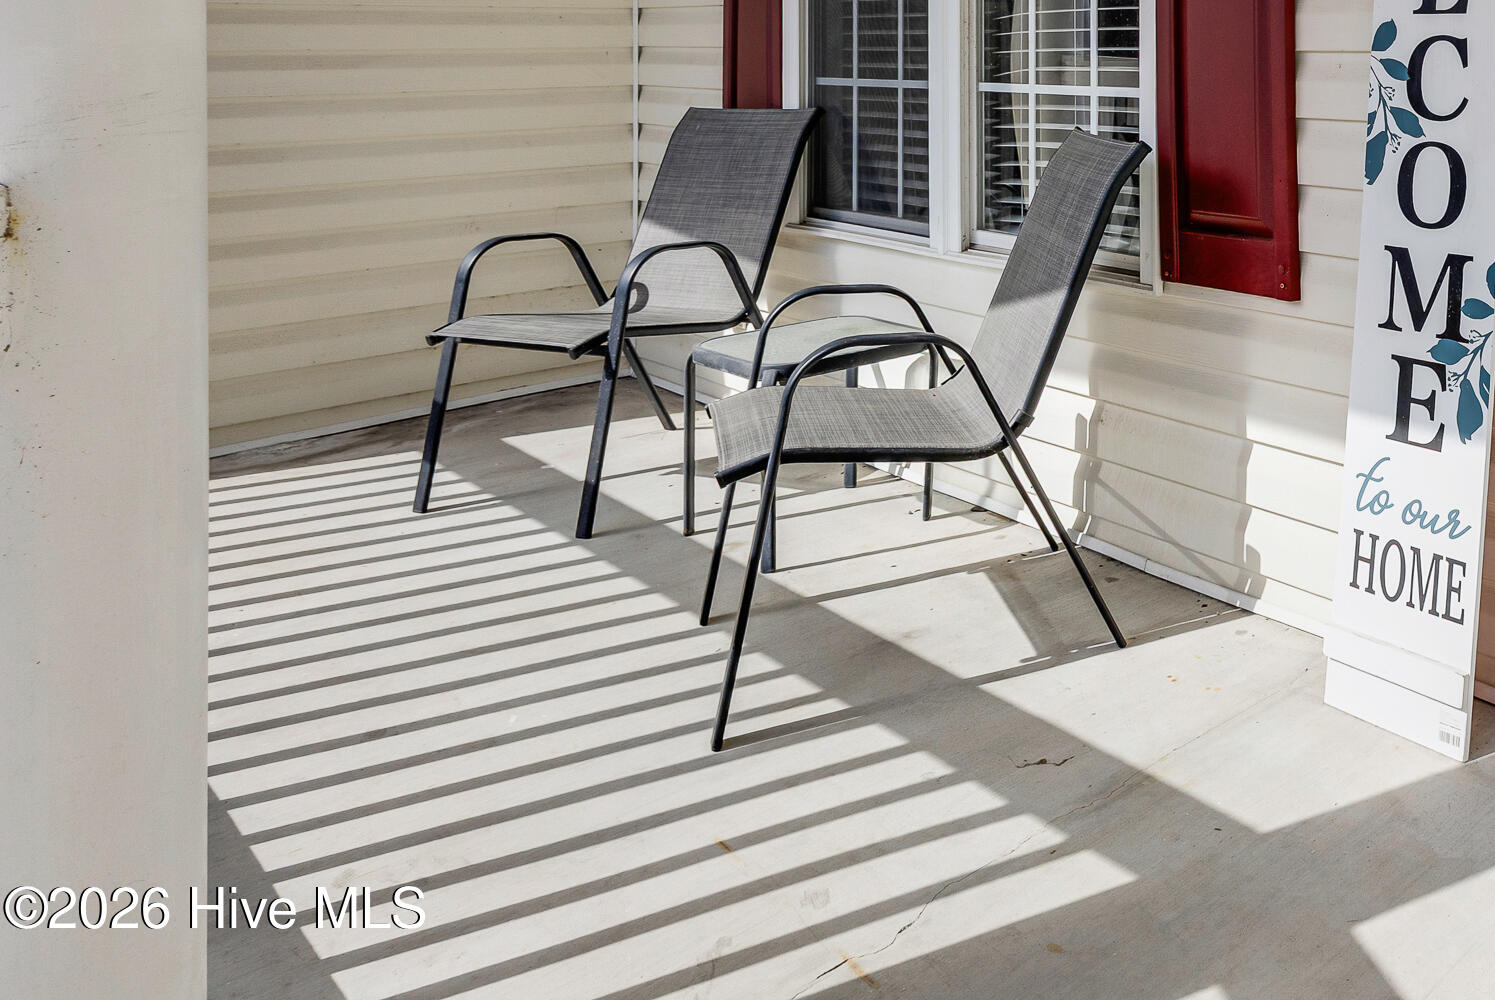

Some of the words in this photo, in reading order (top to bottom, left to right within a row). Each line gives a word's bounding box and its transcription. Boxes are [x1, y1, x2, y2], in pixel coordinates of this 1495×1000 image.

[1356, 456, 1394, 516] to
[1401, 498, 1472, 540] our
[1349, 528, 1467, 626] HOME
